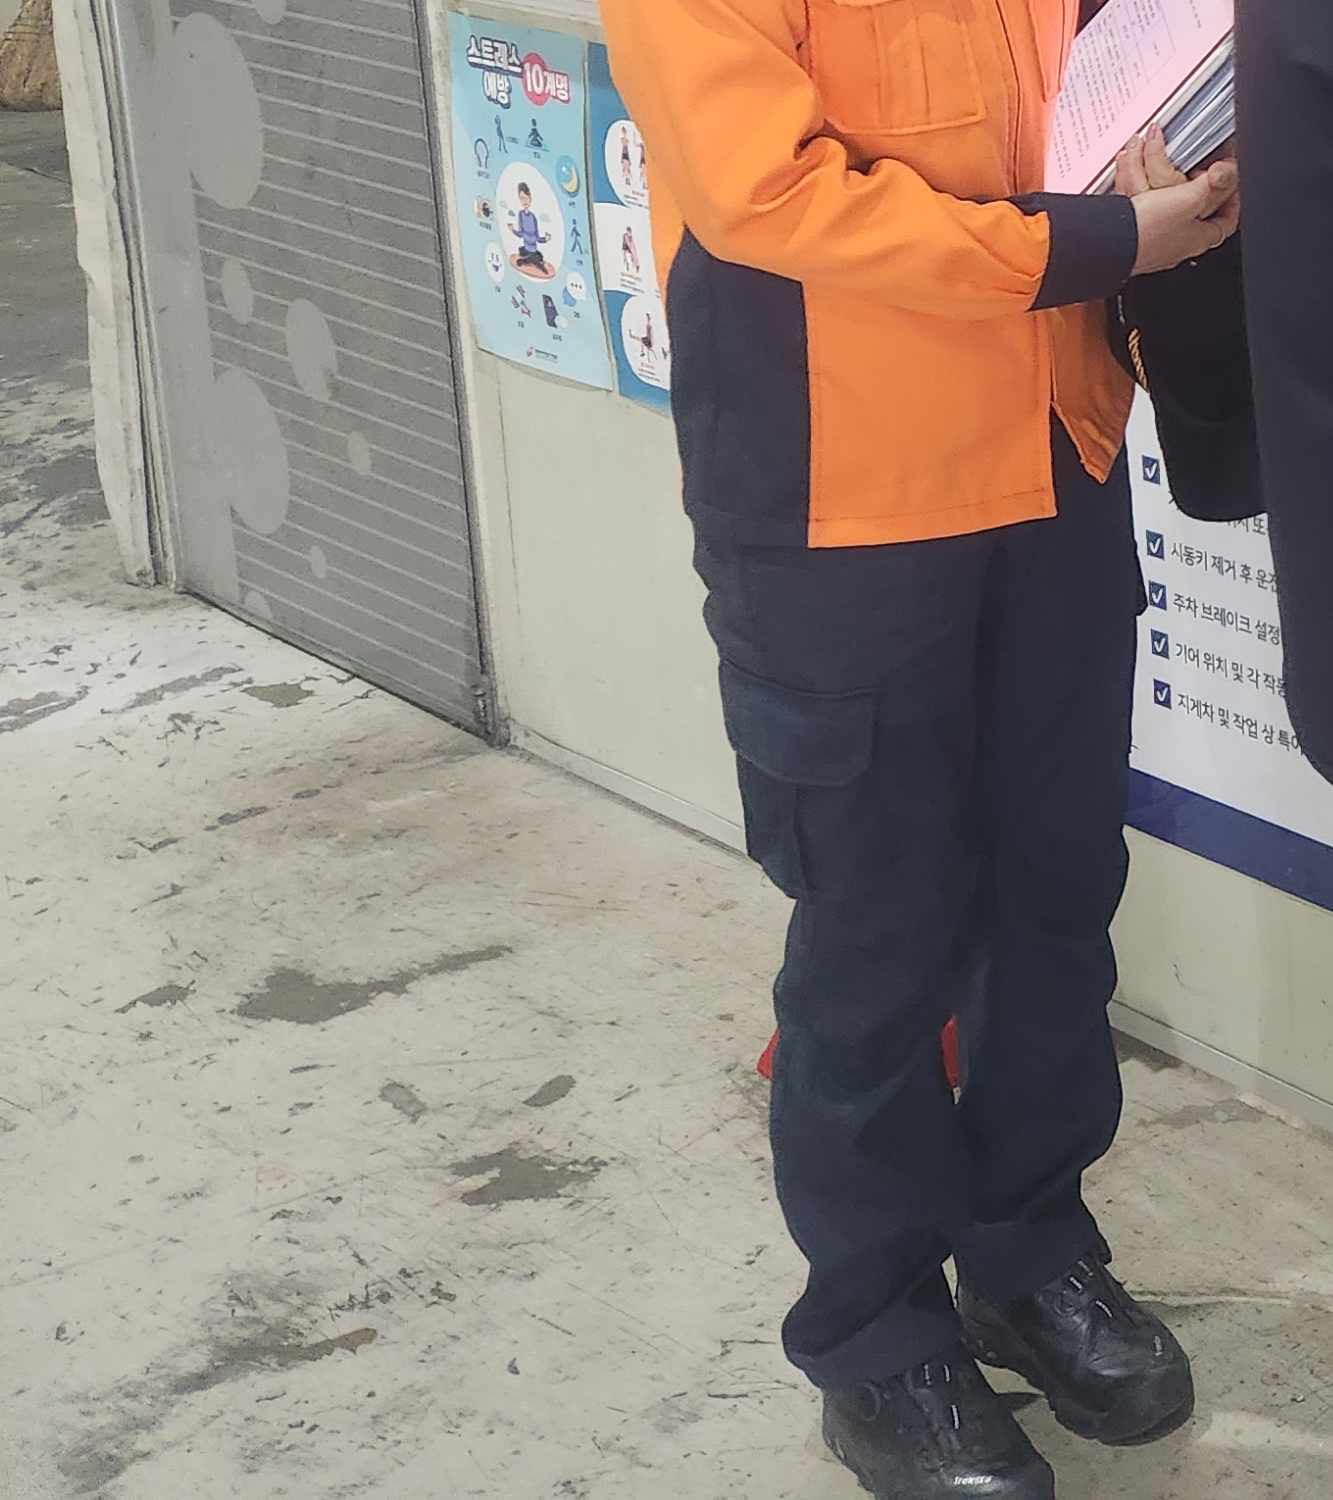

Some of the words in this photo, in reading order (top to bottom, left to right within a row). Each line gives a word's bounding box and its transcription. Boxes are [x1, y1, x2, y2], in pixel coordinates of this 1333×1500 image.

[467, 35, 522, 74] 스트레스
[524, 62, 569, 102] 10계명
[1172, 543, 1207, 571] 시동키
[1212, 555, 1236, 580] 제거
[1240, 564, 1252, 583] 후
[1174, 593, 1198, 618] 주차
[1201, 602, 1252, 634] 브레이크
[1176, 643, 1199, 668] 기어
[1203, 652, 1228, 678] 위치
[1232, 662, 1243, 683] 및
[1247, 668, 1260, 689] 각
[1178, 694, 1214, 723] 지게차
[1218, 708, 1230, 728] 및
[1233, 713, 1258, 739] 작업
[1262, 724, 1274, 744] 상
